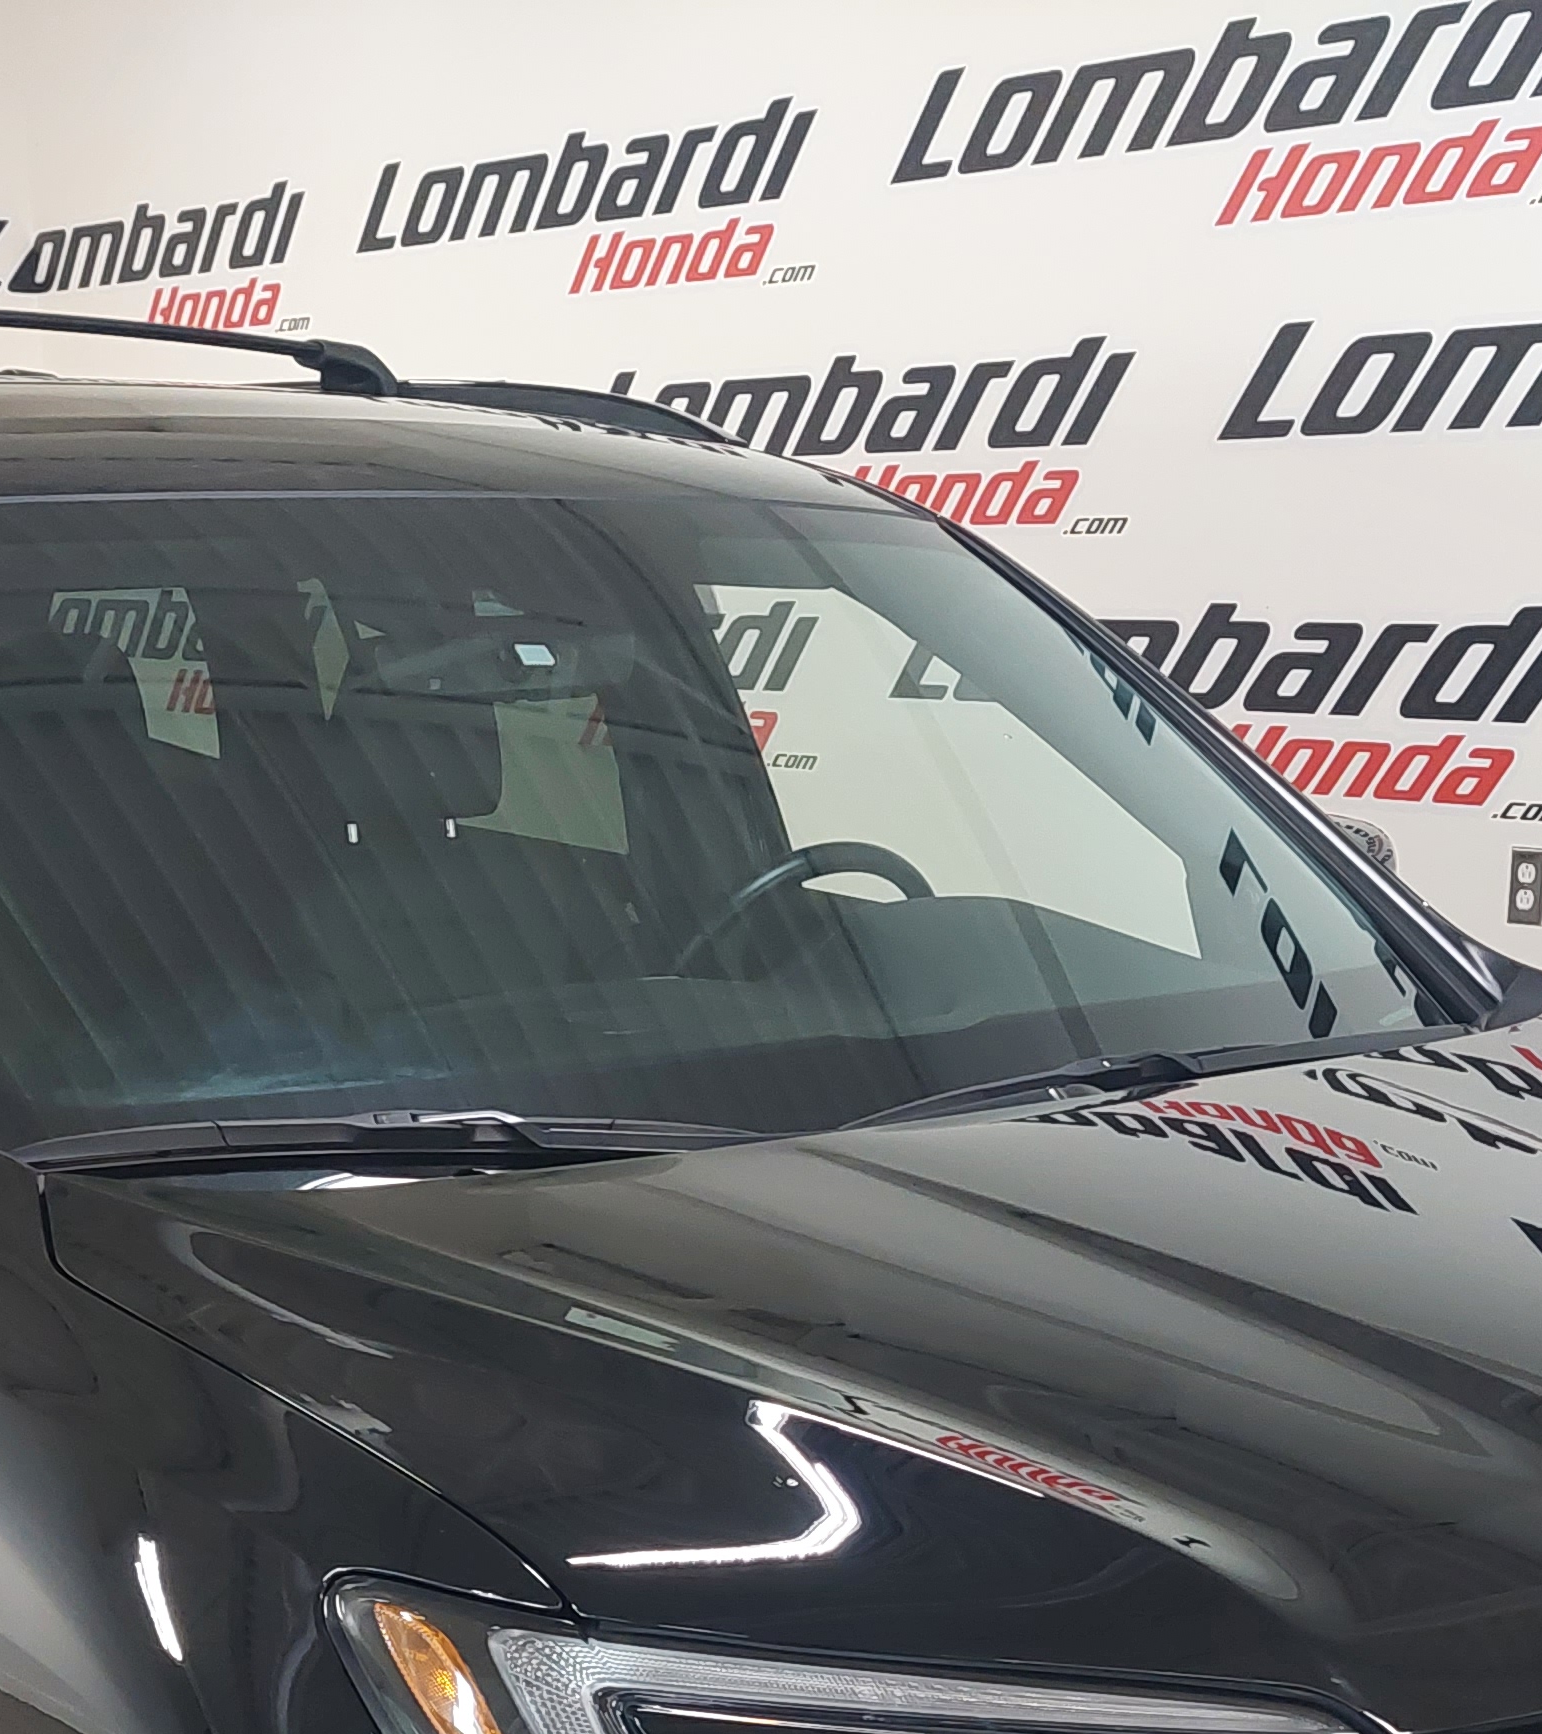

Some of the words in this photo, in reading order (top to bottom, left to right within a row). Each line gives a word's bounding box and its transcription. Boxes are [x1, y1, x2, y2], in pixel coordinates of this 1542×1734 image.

[357, 98, 816, 253] Lombardi
[570, 218, 774, 294] Honda
[767, 264, 816, 285] .com
[147, 277, 281, 331] Honda
[610, 336, 1136, 456] mbardi
[1062, 516, 1129, 535] .com
[766, 753, 818, 771] .com
